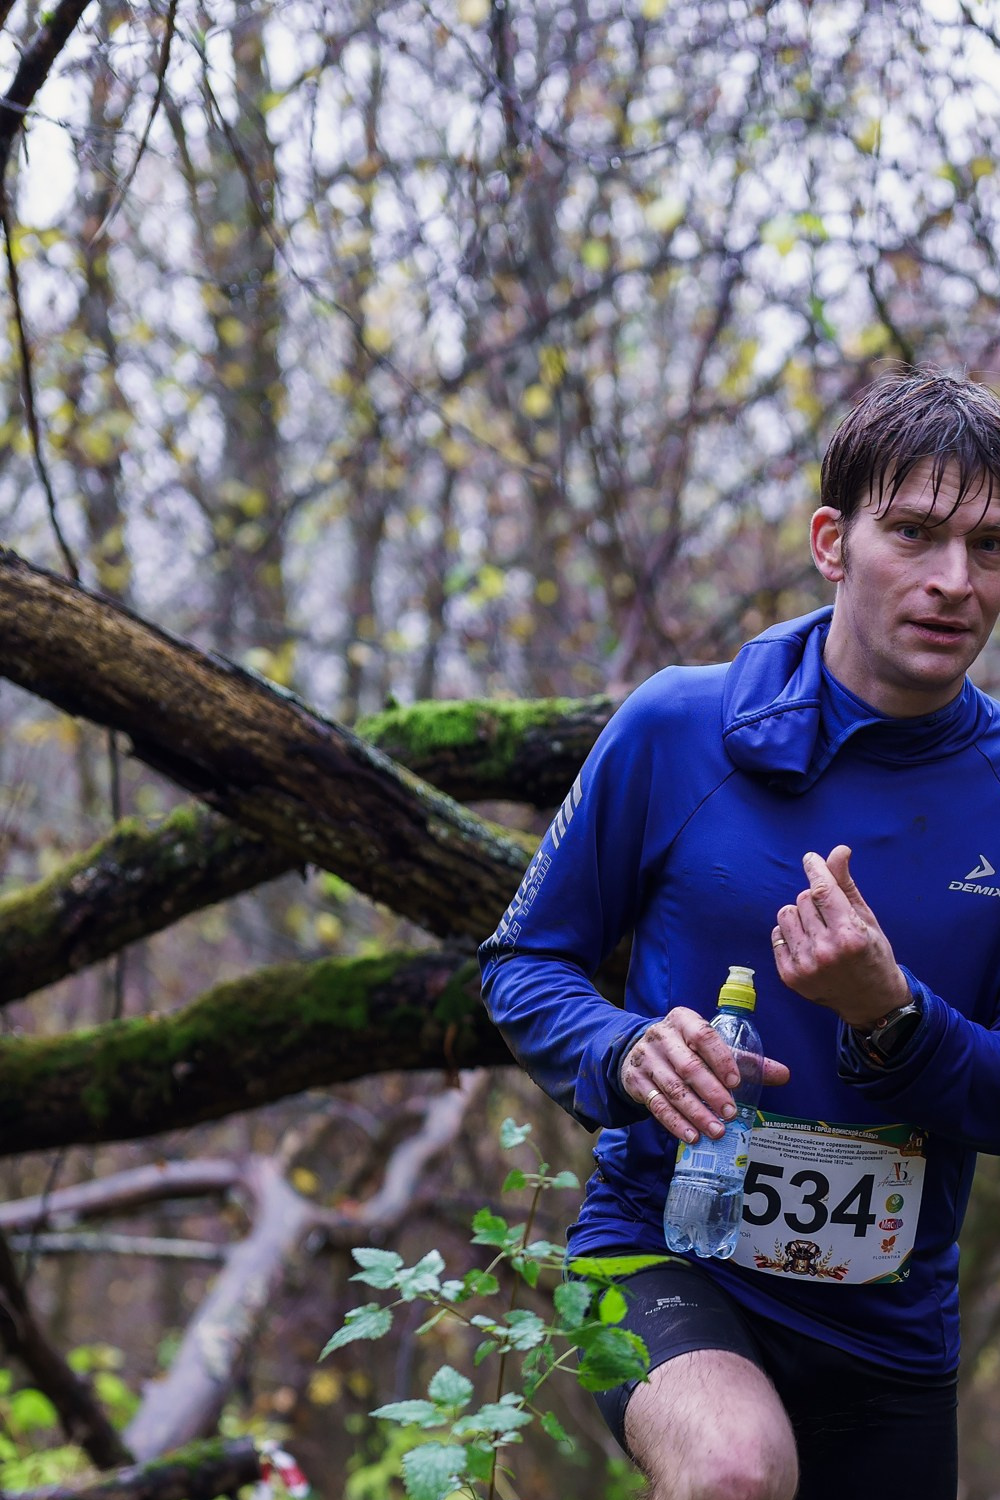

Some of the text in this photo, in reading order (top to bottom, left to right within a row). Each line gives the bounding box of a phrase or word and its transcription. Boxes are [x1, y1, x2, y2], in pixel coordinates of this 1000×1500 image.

[815, 1126, 831, 1134] ГОРОД
[784, 1135, 825, 1147] Всероссийские
[743, 1161, 876, 1238] 534
